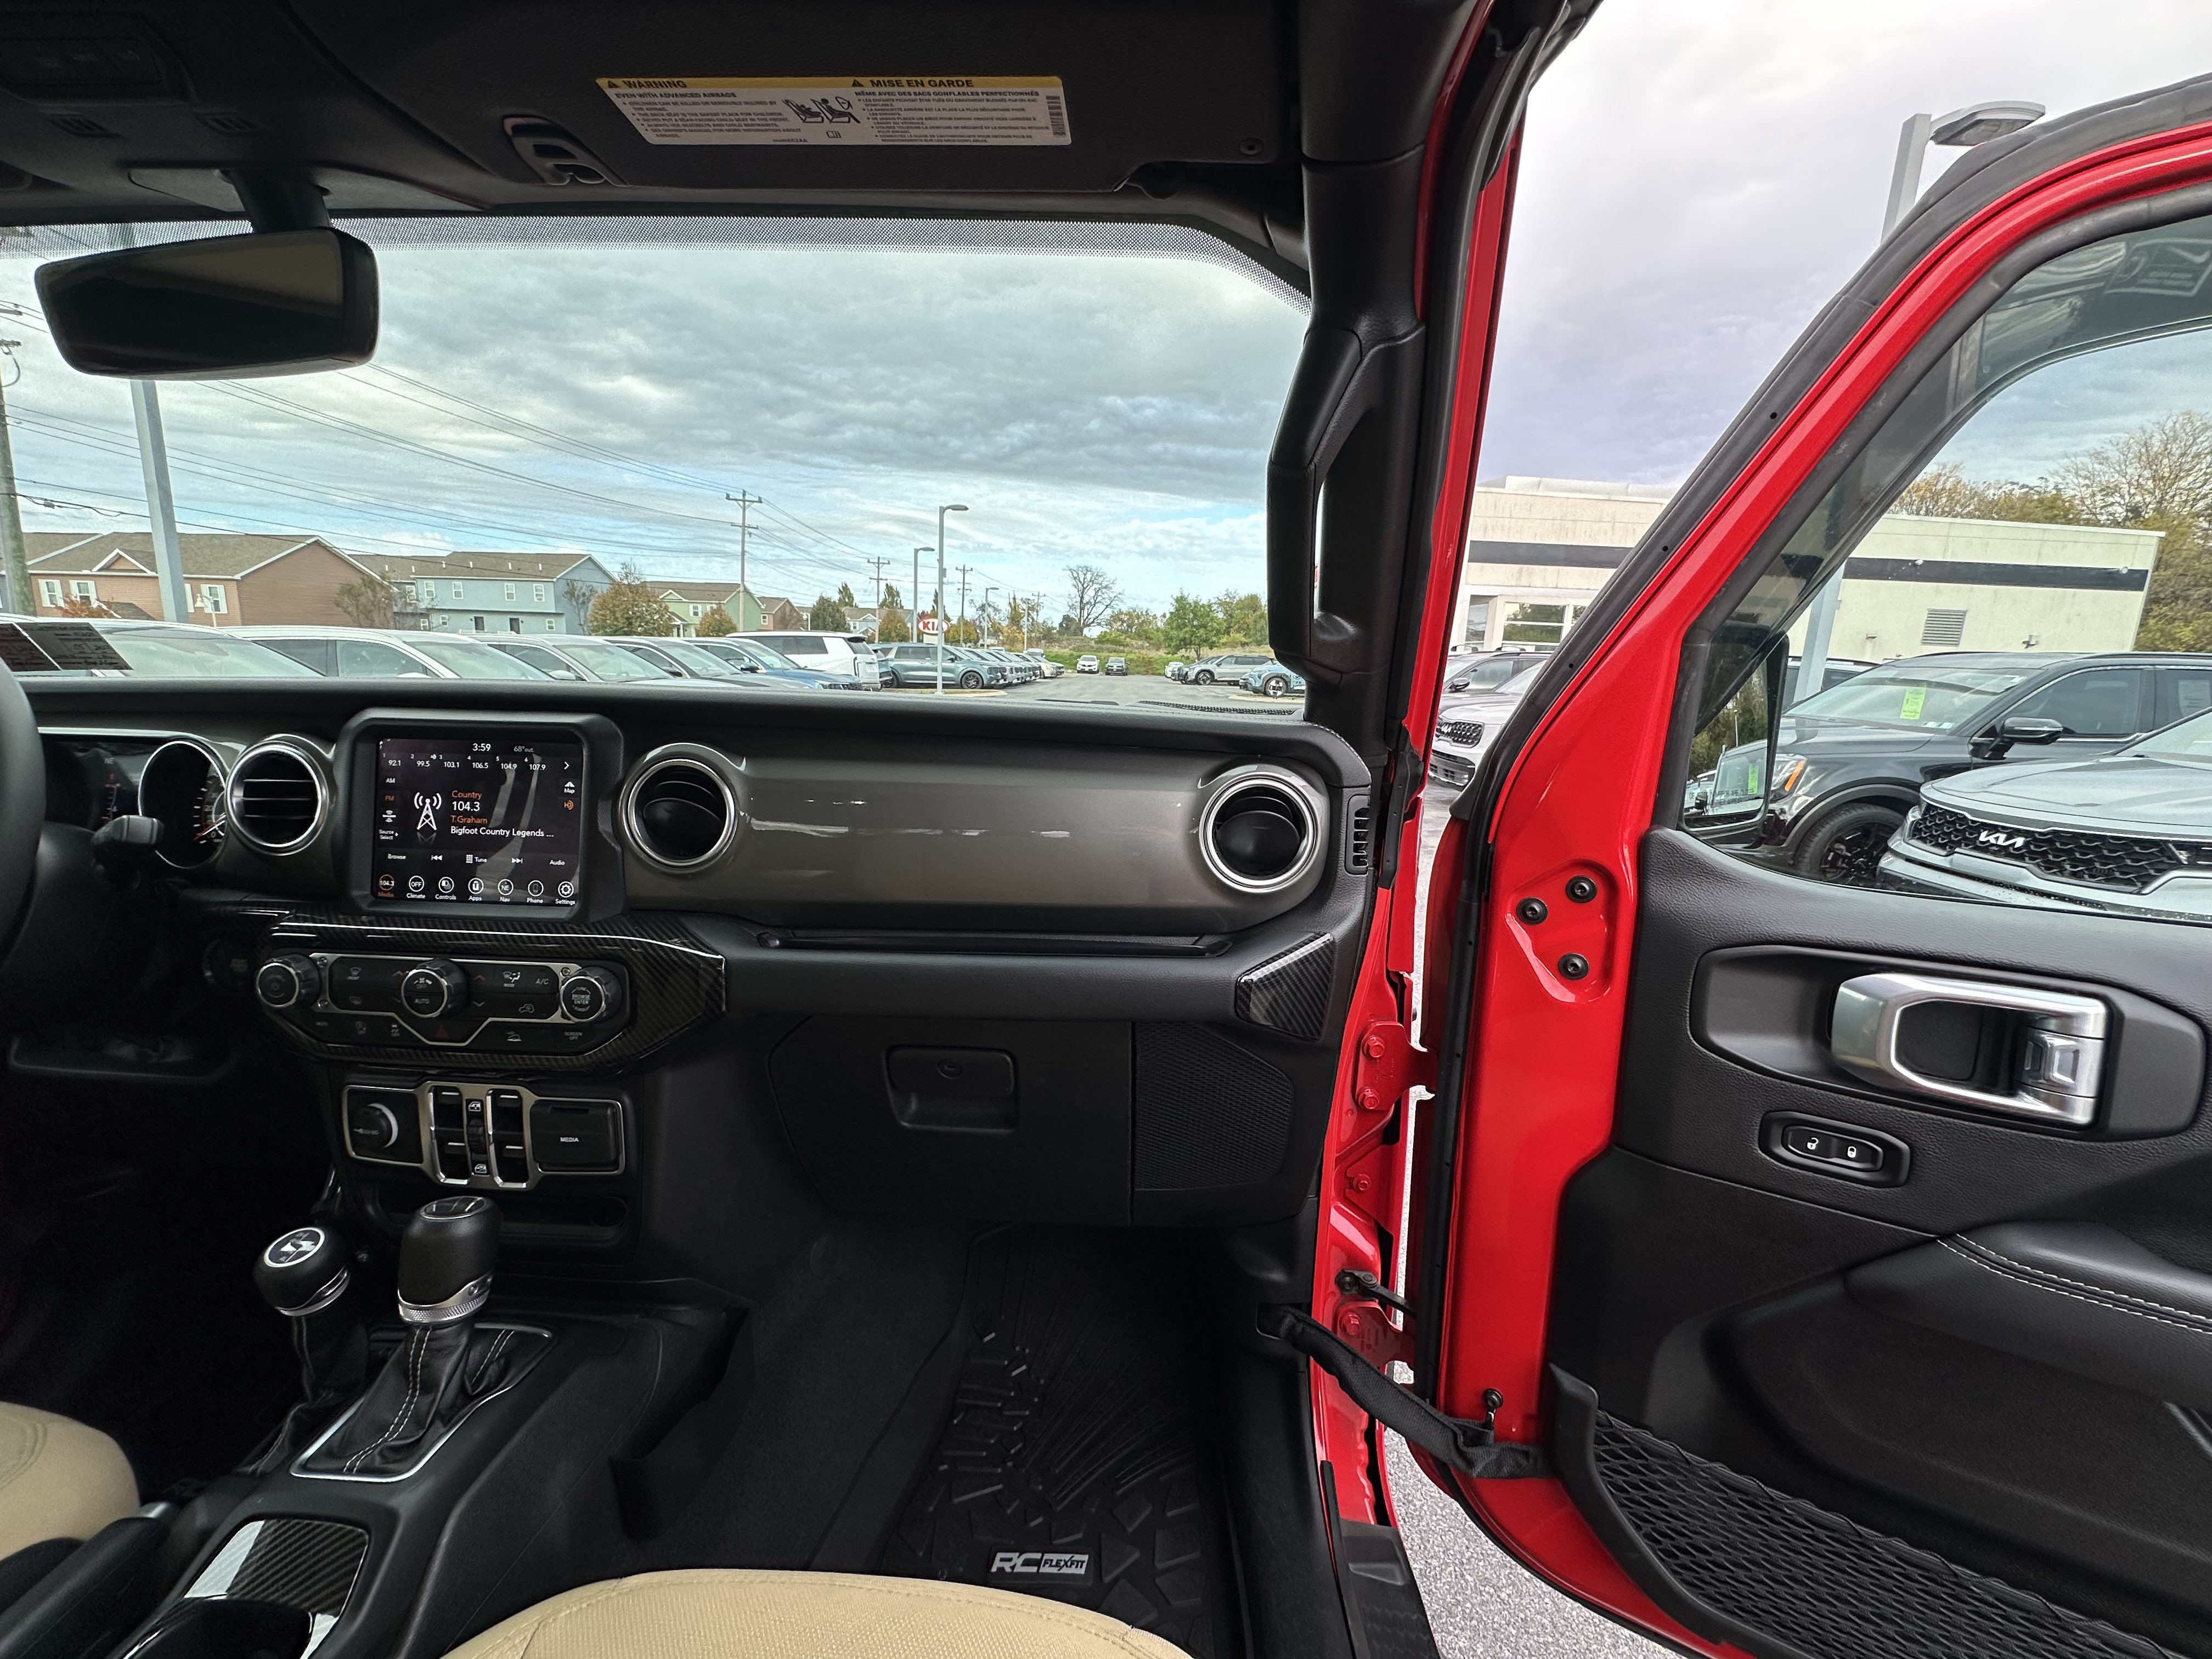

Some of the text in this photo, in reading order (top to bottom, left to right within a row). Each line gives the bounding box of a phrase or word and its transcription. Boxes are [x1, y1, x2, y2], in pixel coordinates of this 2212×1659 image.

[622, 80, 687, 88] WARNING
[472, 743, 492, 752] 3:59
[452, 790, 482, 800] Country
[452, 801, 480, 811] 104.3
[450, 815, 487, 824] T.Graham
[450, 826, 478, 836] Bigfoot
[479, 827, 510, 837] Country
[512, 828, 544, 838] Legends
[1043, 1556, 1086, 1571] FLEXFIT
